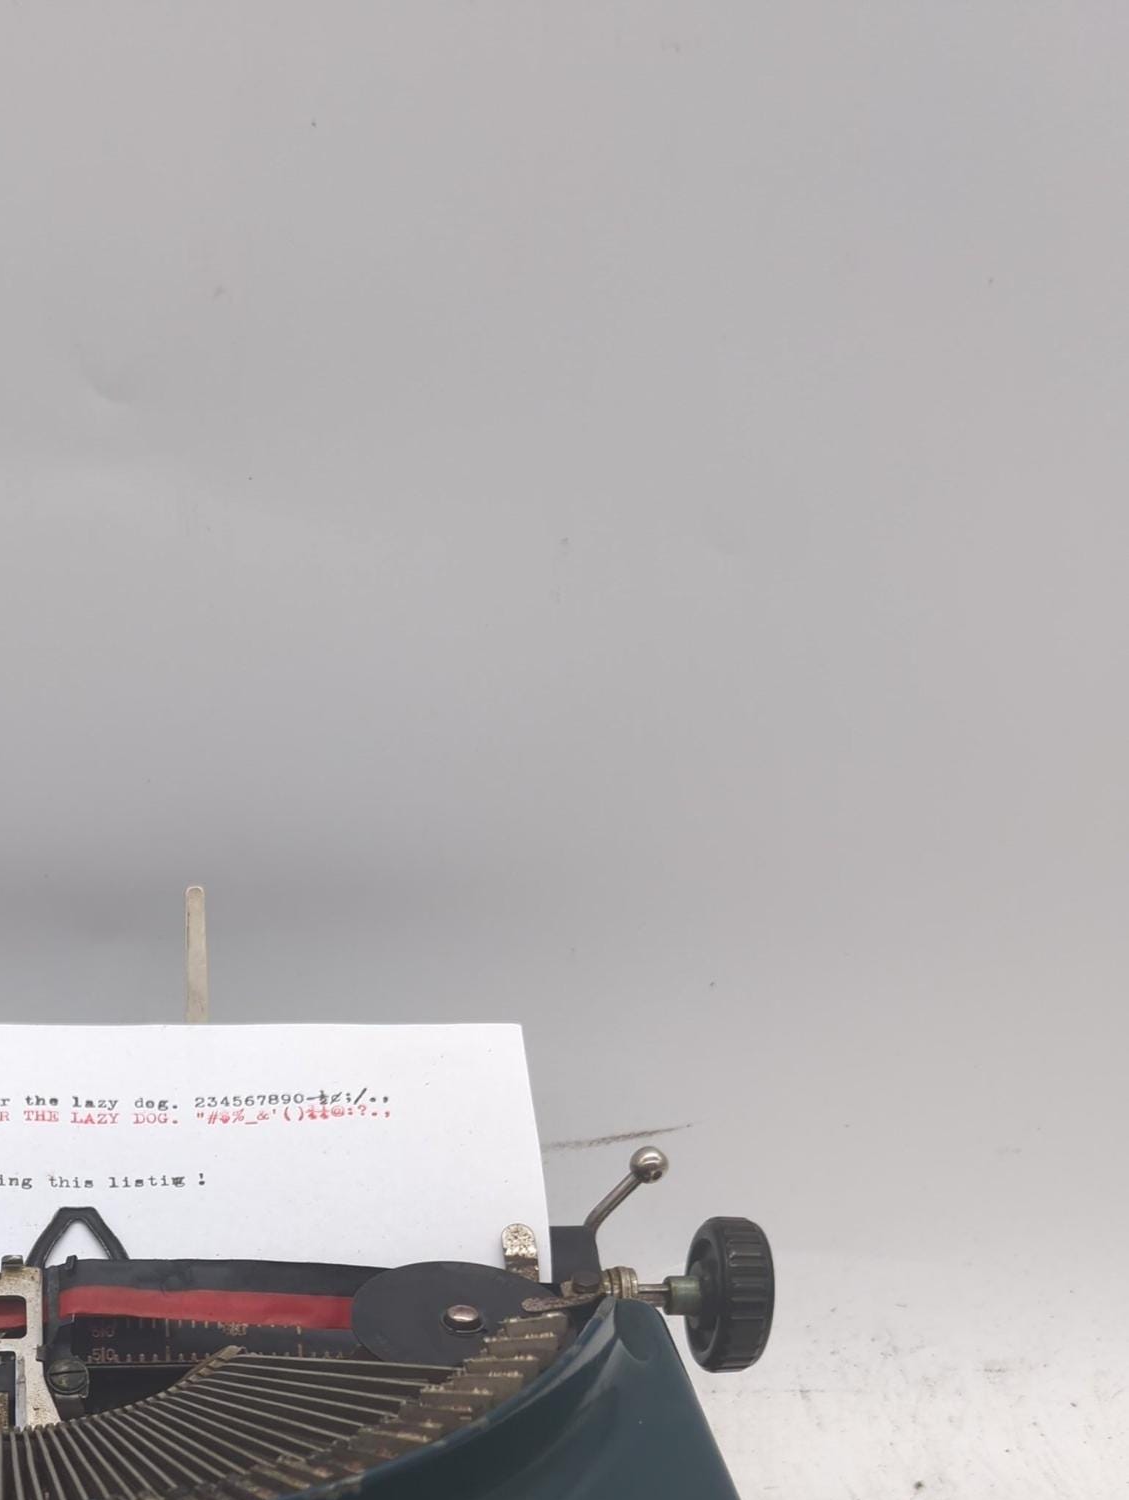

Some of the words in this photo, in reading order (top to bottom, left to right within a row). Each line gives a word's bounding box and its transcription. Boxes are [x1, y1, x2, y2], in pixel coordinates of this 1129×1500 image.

[25, 1095, 59, 1107] the
[72, 1096, 119, 1110] lazy
[134, 1096, 179, 1110] dog.
[23, 1110, 59, 1123] THE
[70, 1111, 119, 1125] LAZY
[133, 1111, 179, 1125] DOG.
[48, 1174, 94, 1189] this
